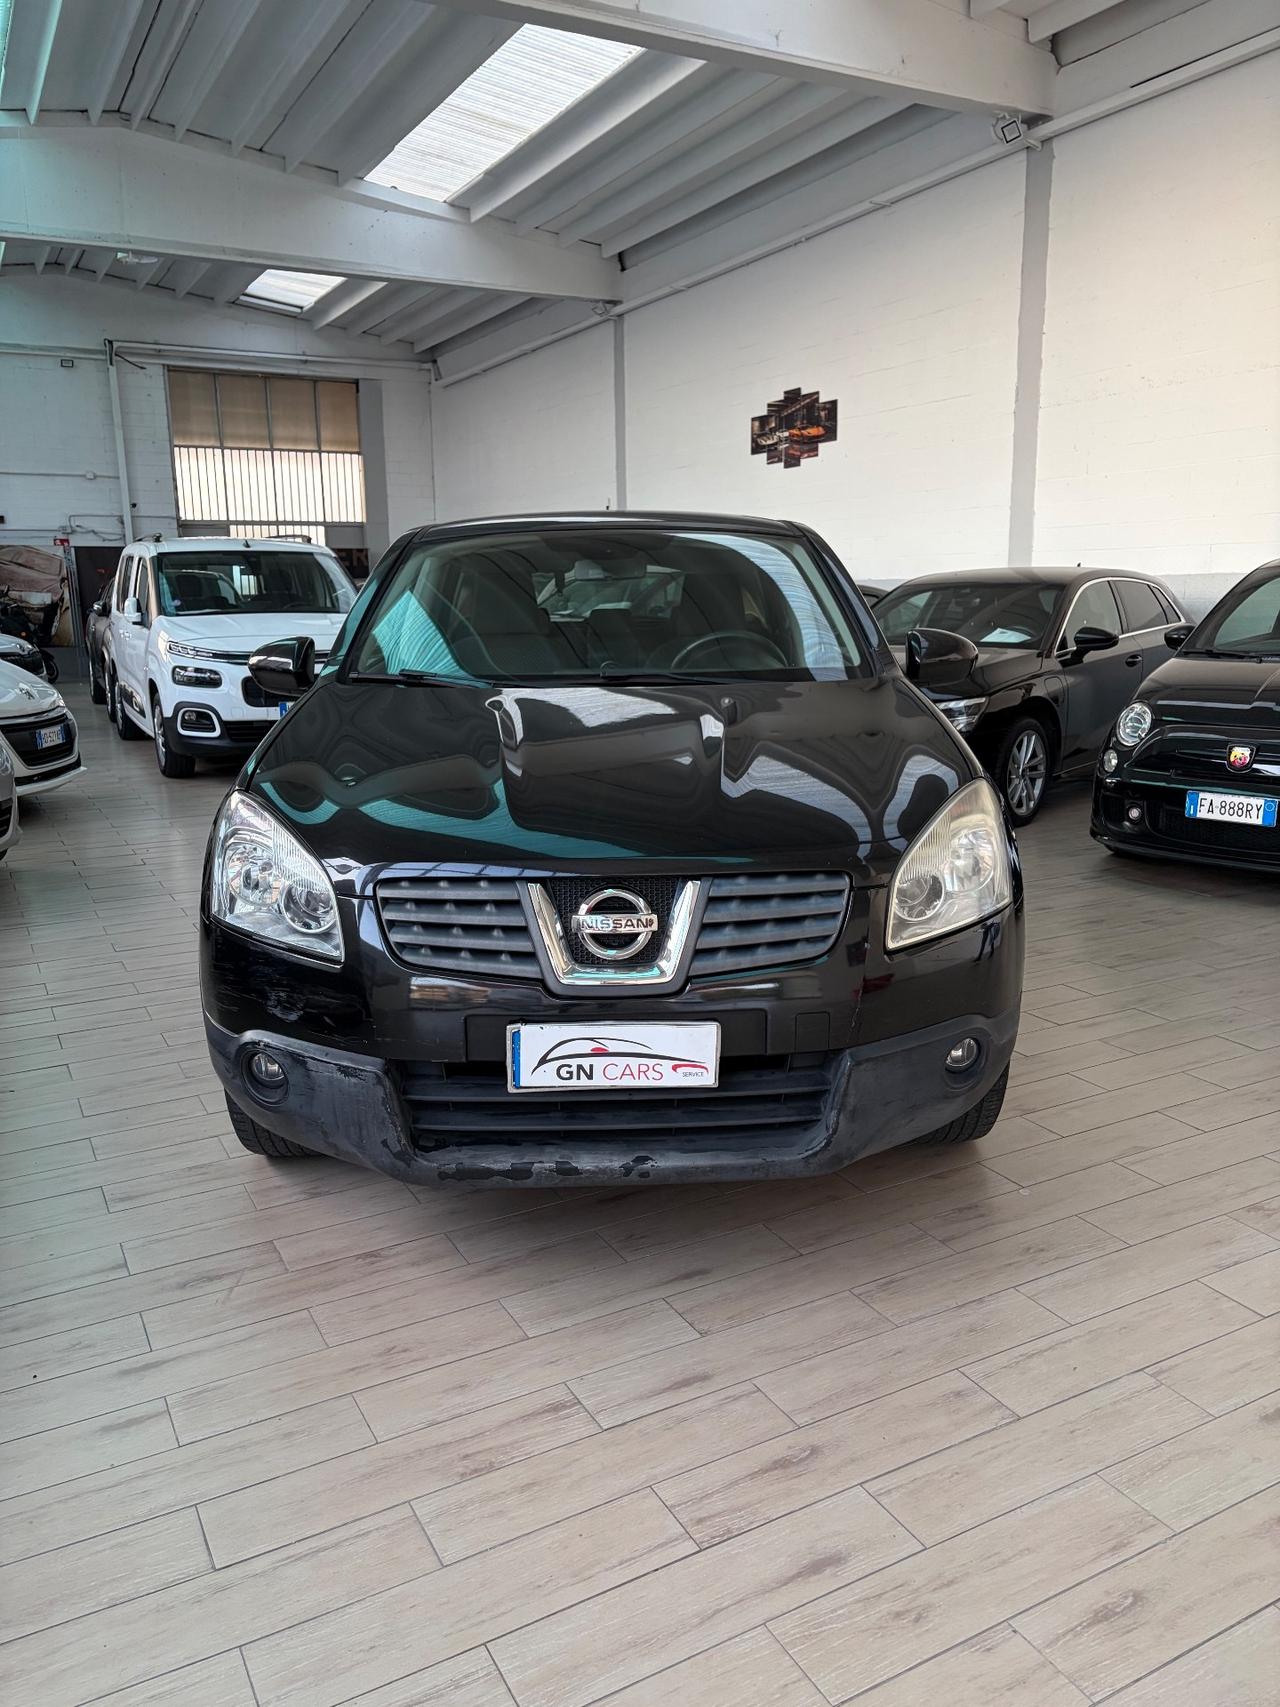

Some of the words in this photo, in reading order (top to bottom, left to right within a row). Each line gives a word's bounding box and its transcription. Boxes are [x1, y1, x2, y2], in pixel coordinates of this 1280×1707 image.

[580, 918, 649, 929] NISSAN
[556, 1063, 594, 1081] GN
[602, 1063, 664, 1081] CARS
